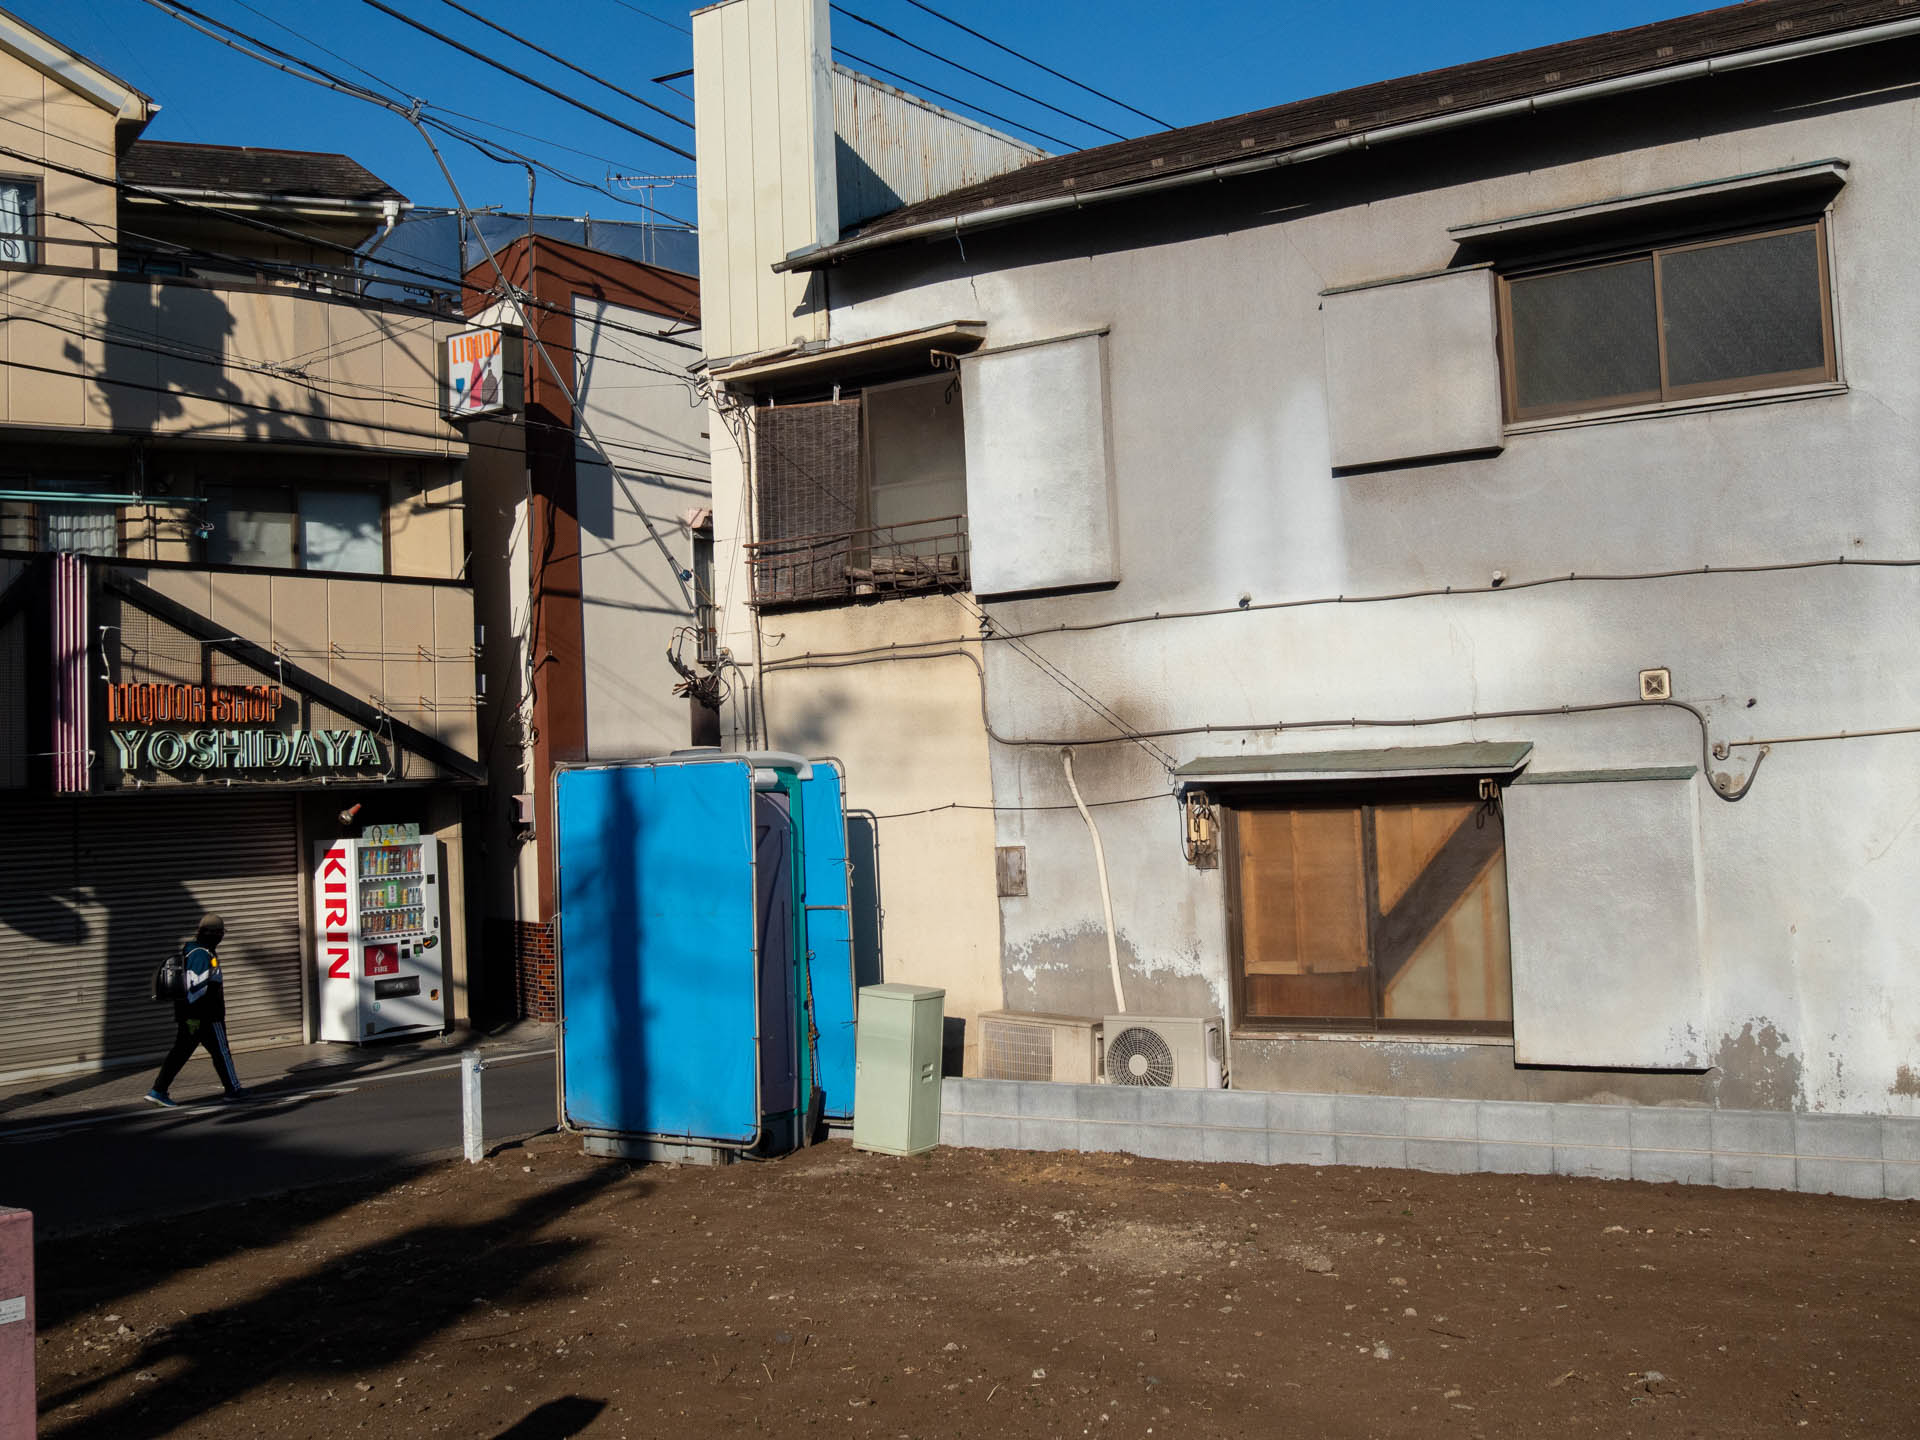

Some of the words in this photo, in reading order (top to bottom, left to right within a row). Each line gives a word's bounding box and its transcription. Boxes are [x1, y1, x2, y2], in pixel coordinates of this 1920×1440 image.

[452, 330, 500, 363] LIQUOR
[109, 683, 206, 724] LIQUOR
[212, 685, 281, 723] SHOP
[112, 729, 380, 770] YOSHIDAYA
[323, 848, 350, 979] KIRIN
